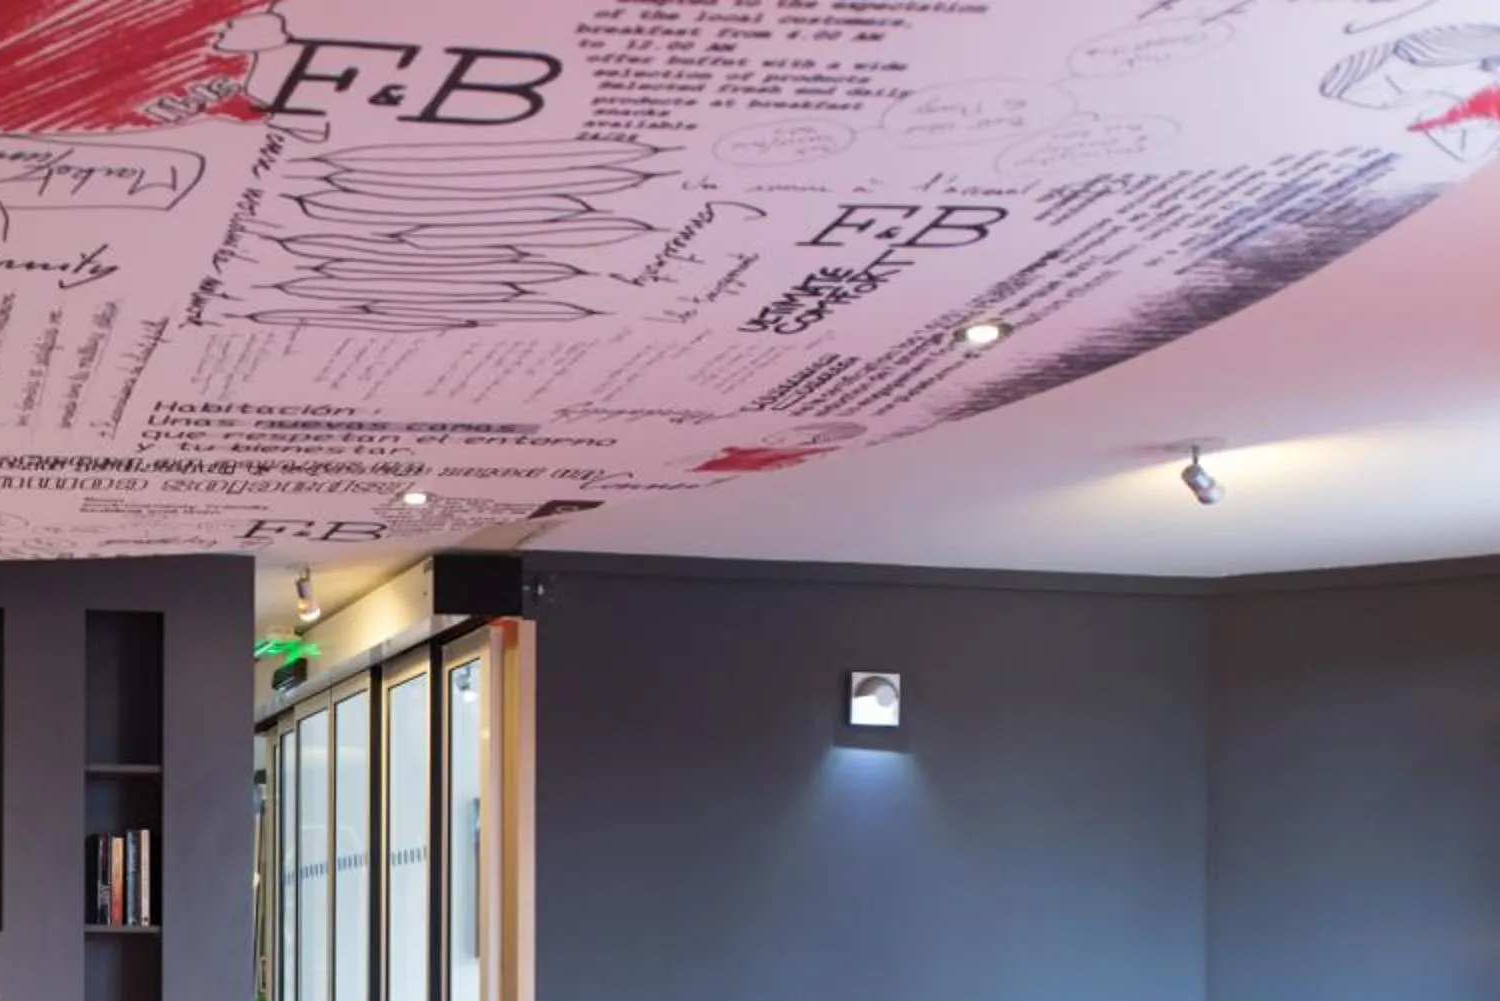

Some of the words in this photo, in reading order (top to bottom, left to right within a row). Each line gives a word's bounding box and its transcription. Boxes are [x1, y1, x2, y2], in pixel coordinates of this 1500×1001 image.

[594, 9, 626, 20] of
[639, 9, 681, 22] the
[692, 11, 764, 25] local
[574, 22, 702, 38] breakfast
[714, 27, 773, 40] from
[578, 38, 606, 50] to
[703, 42, 738, 53] AM
[586, 53, 656, 66] offer
[666, 55, 749, 69] buffet
[760, 58, 816, 71] with
[852, 60, 909, 72] wide
[280, 38, 563, 126] F&B
[592, 68, 713, 82] selection
[725, 70, 754, 82] of
[762, 73, 872, 87] products
[716, 83, 783, 96] fresh
[793, 86, 836, 97] and
[845, 87, 916, 100] daily
[590, 96, 699, 110] products
[709, 98, 736, 109] at
[748, 98, 865, 112] breakfast
[581, 120, 699, 131] available
[796, 203, 1008, 248] F&B
[152, 399, 357, 416] Habitación
[145, 415, 236, 430] Unas
[140, 430, 208, 444] que
[221, 430, 401, 446] respetan
[416, 433, 451, 447] el
[462, 436, 619, 448] entorno
[178, 441, 215, 453] tu
